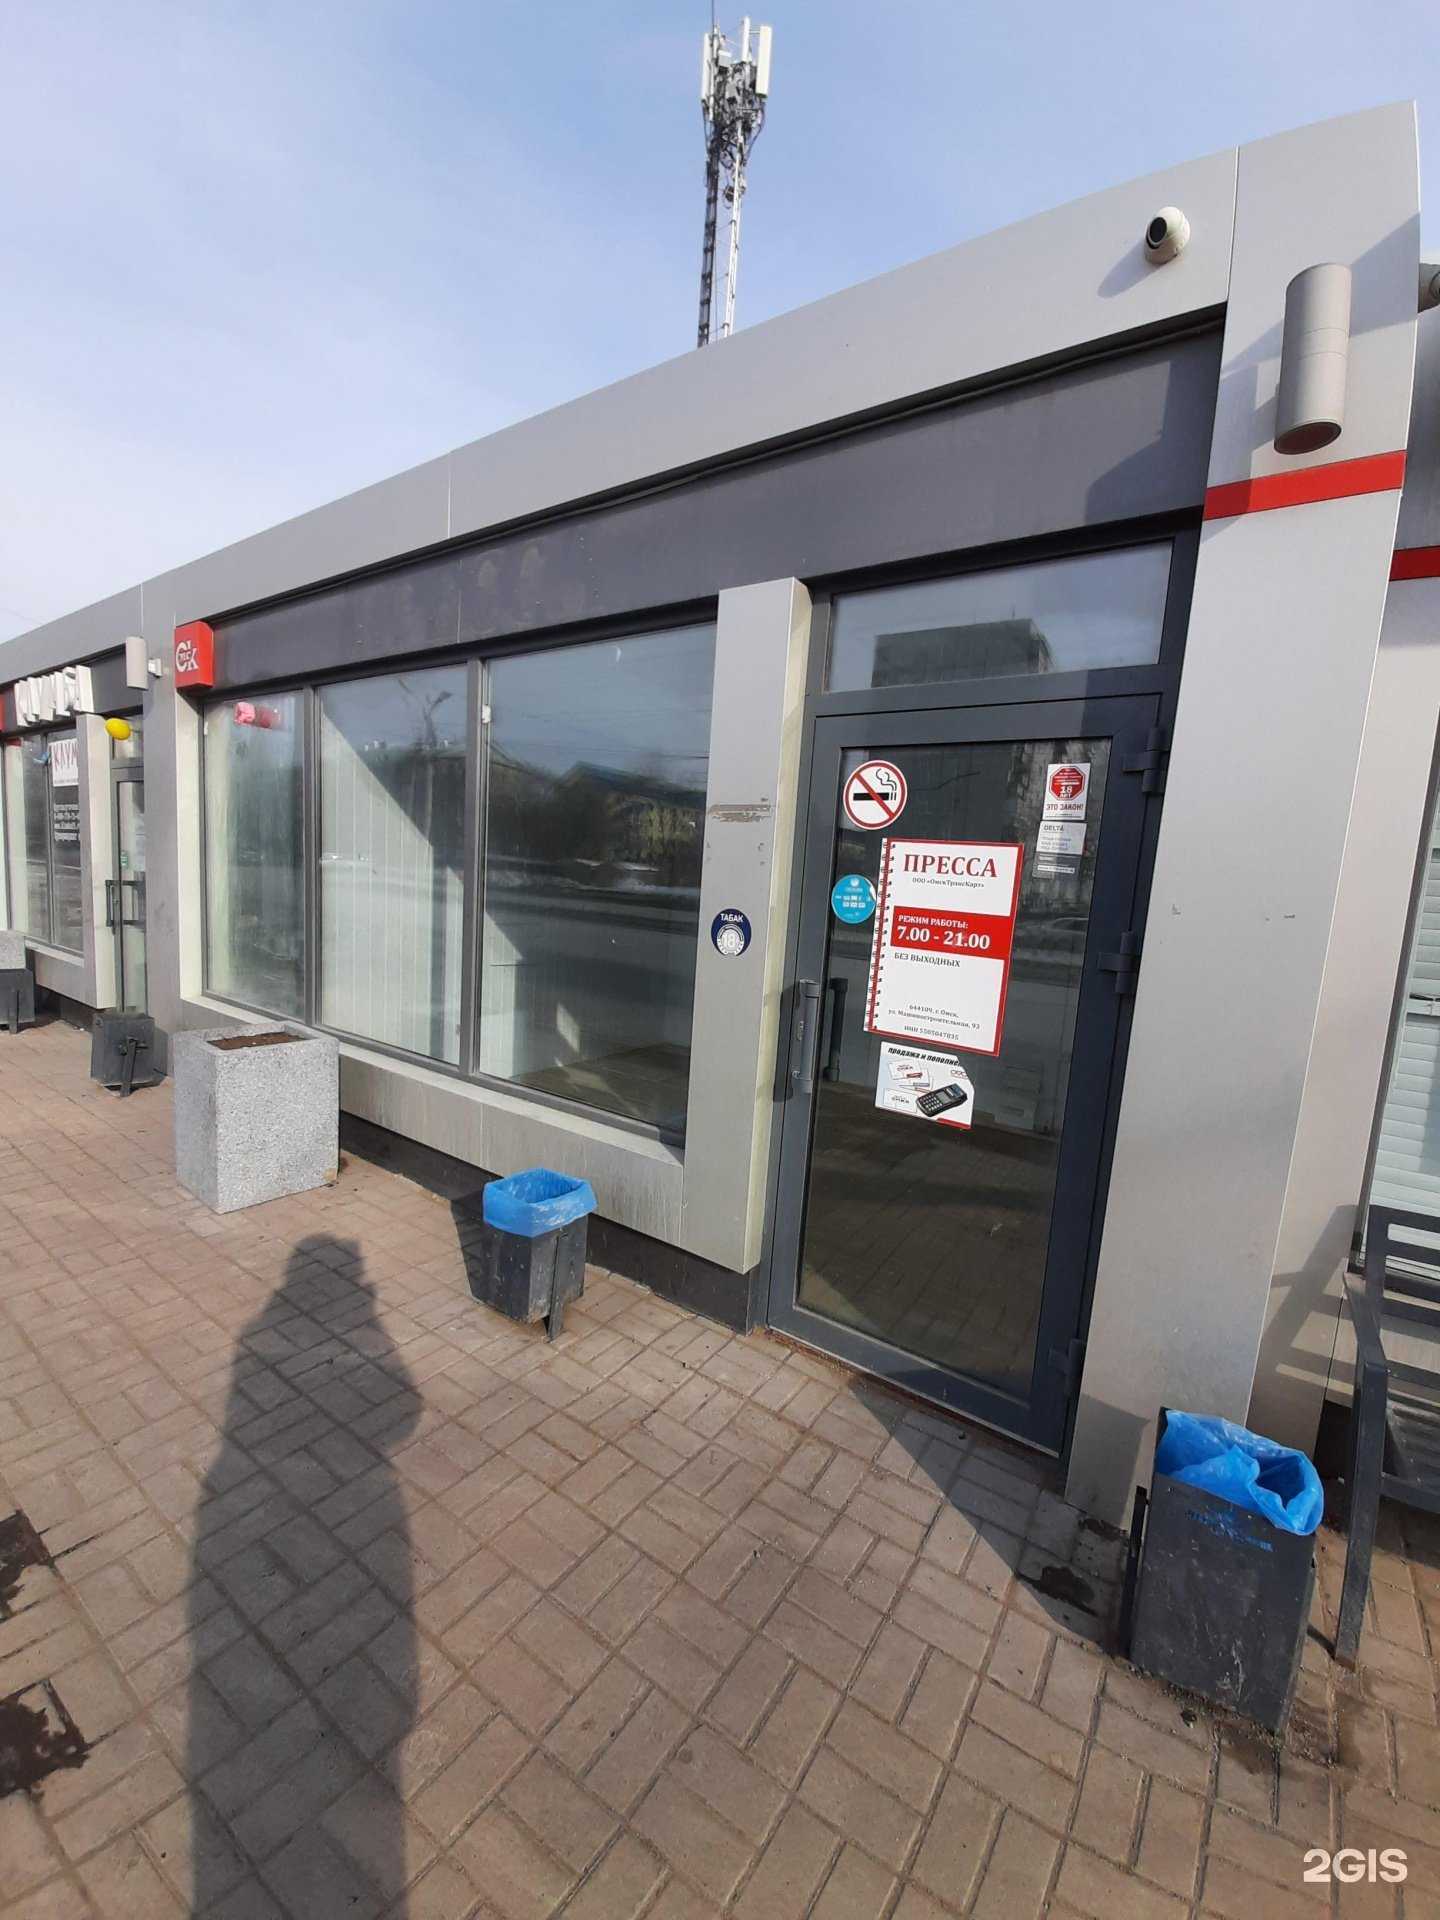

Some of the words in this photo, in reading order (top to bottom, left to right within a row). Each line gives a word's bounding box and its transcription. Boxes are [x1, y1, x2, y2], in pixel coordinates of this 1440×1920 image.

[1046, 803, 1058, 811] ЭТО
[903, 853, 997, 878] ПРЕССА
[720, 913, 744, 923] ТАБАК
[898, 914, 929, 926] РЕЖИМ
[930, 917, 969, 929] РАБОТЫ:
[897, 925, 930, 943] 7.00
[943, 930, 990, 950] 21.00
[894, 952, 909, 961] БЕЗ
[911, 953, 961, 968] ВЫХОДНЫХ
[887, 1047, 920, 1060] продажа
